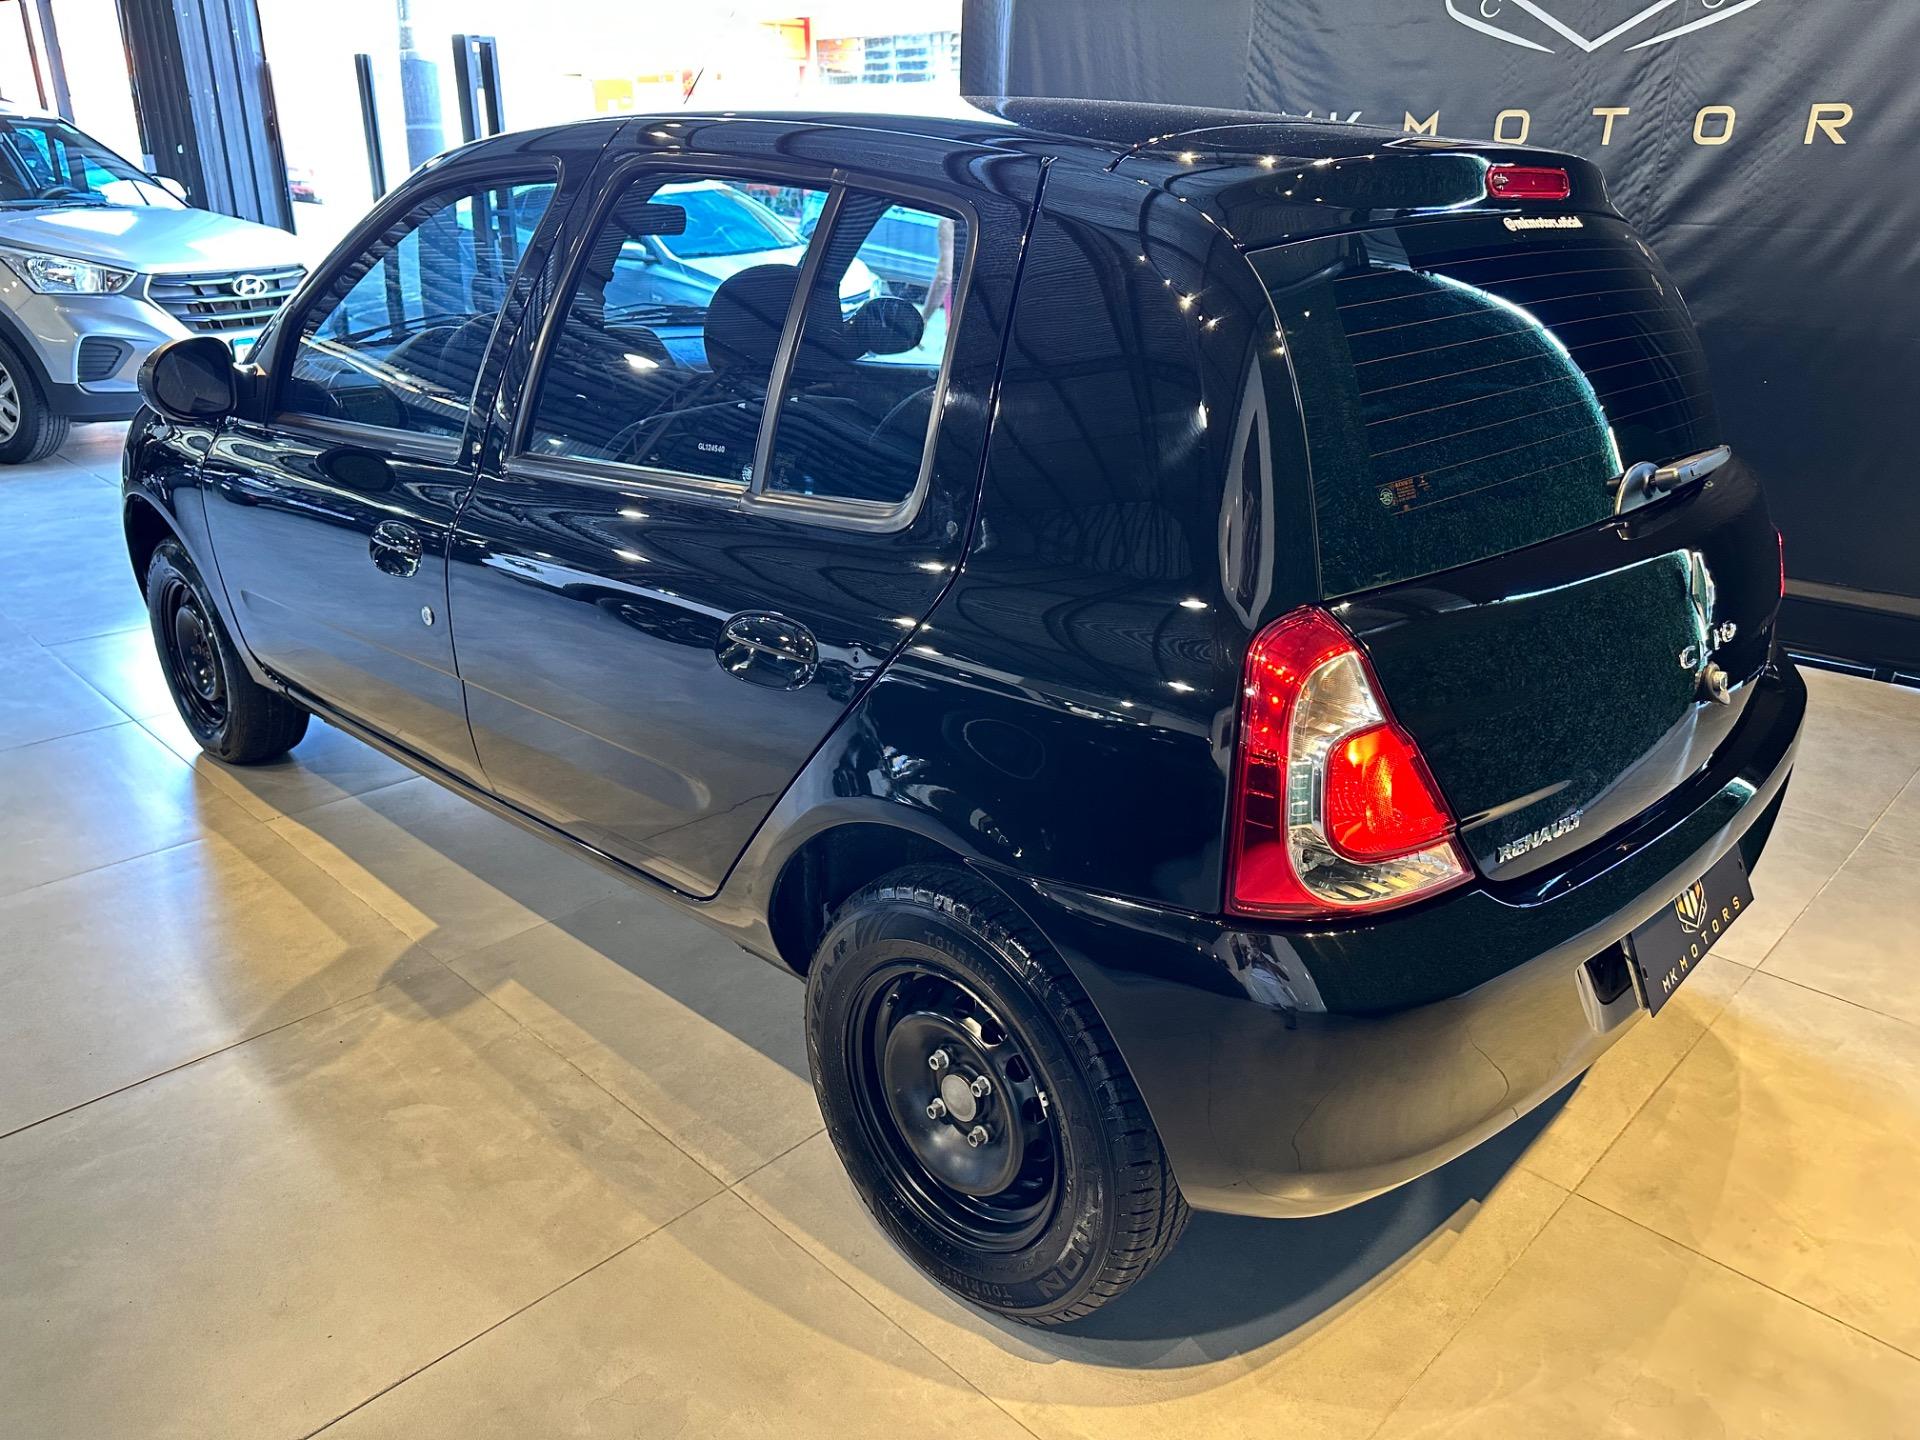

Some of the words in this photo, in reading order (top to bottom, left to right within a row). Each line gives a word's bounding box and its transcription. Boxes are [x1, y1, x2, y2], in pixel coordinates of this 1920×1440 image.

[1497, 809, 1583, 863] RENAULT
[1661, 967, 1678, 993] MK
[1679, 896, 1740, 971] MOTORS
